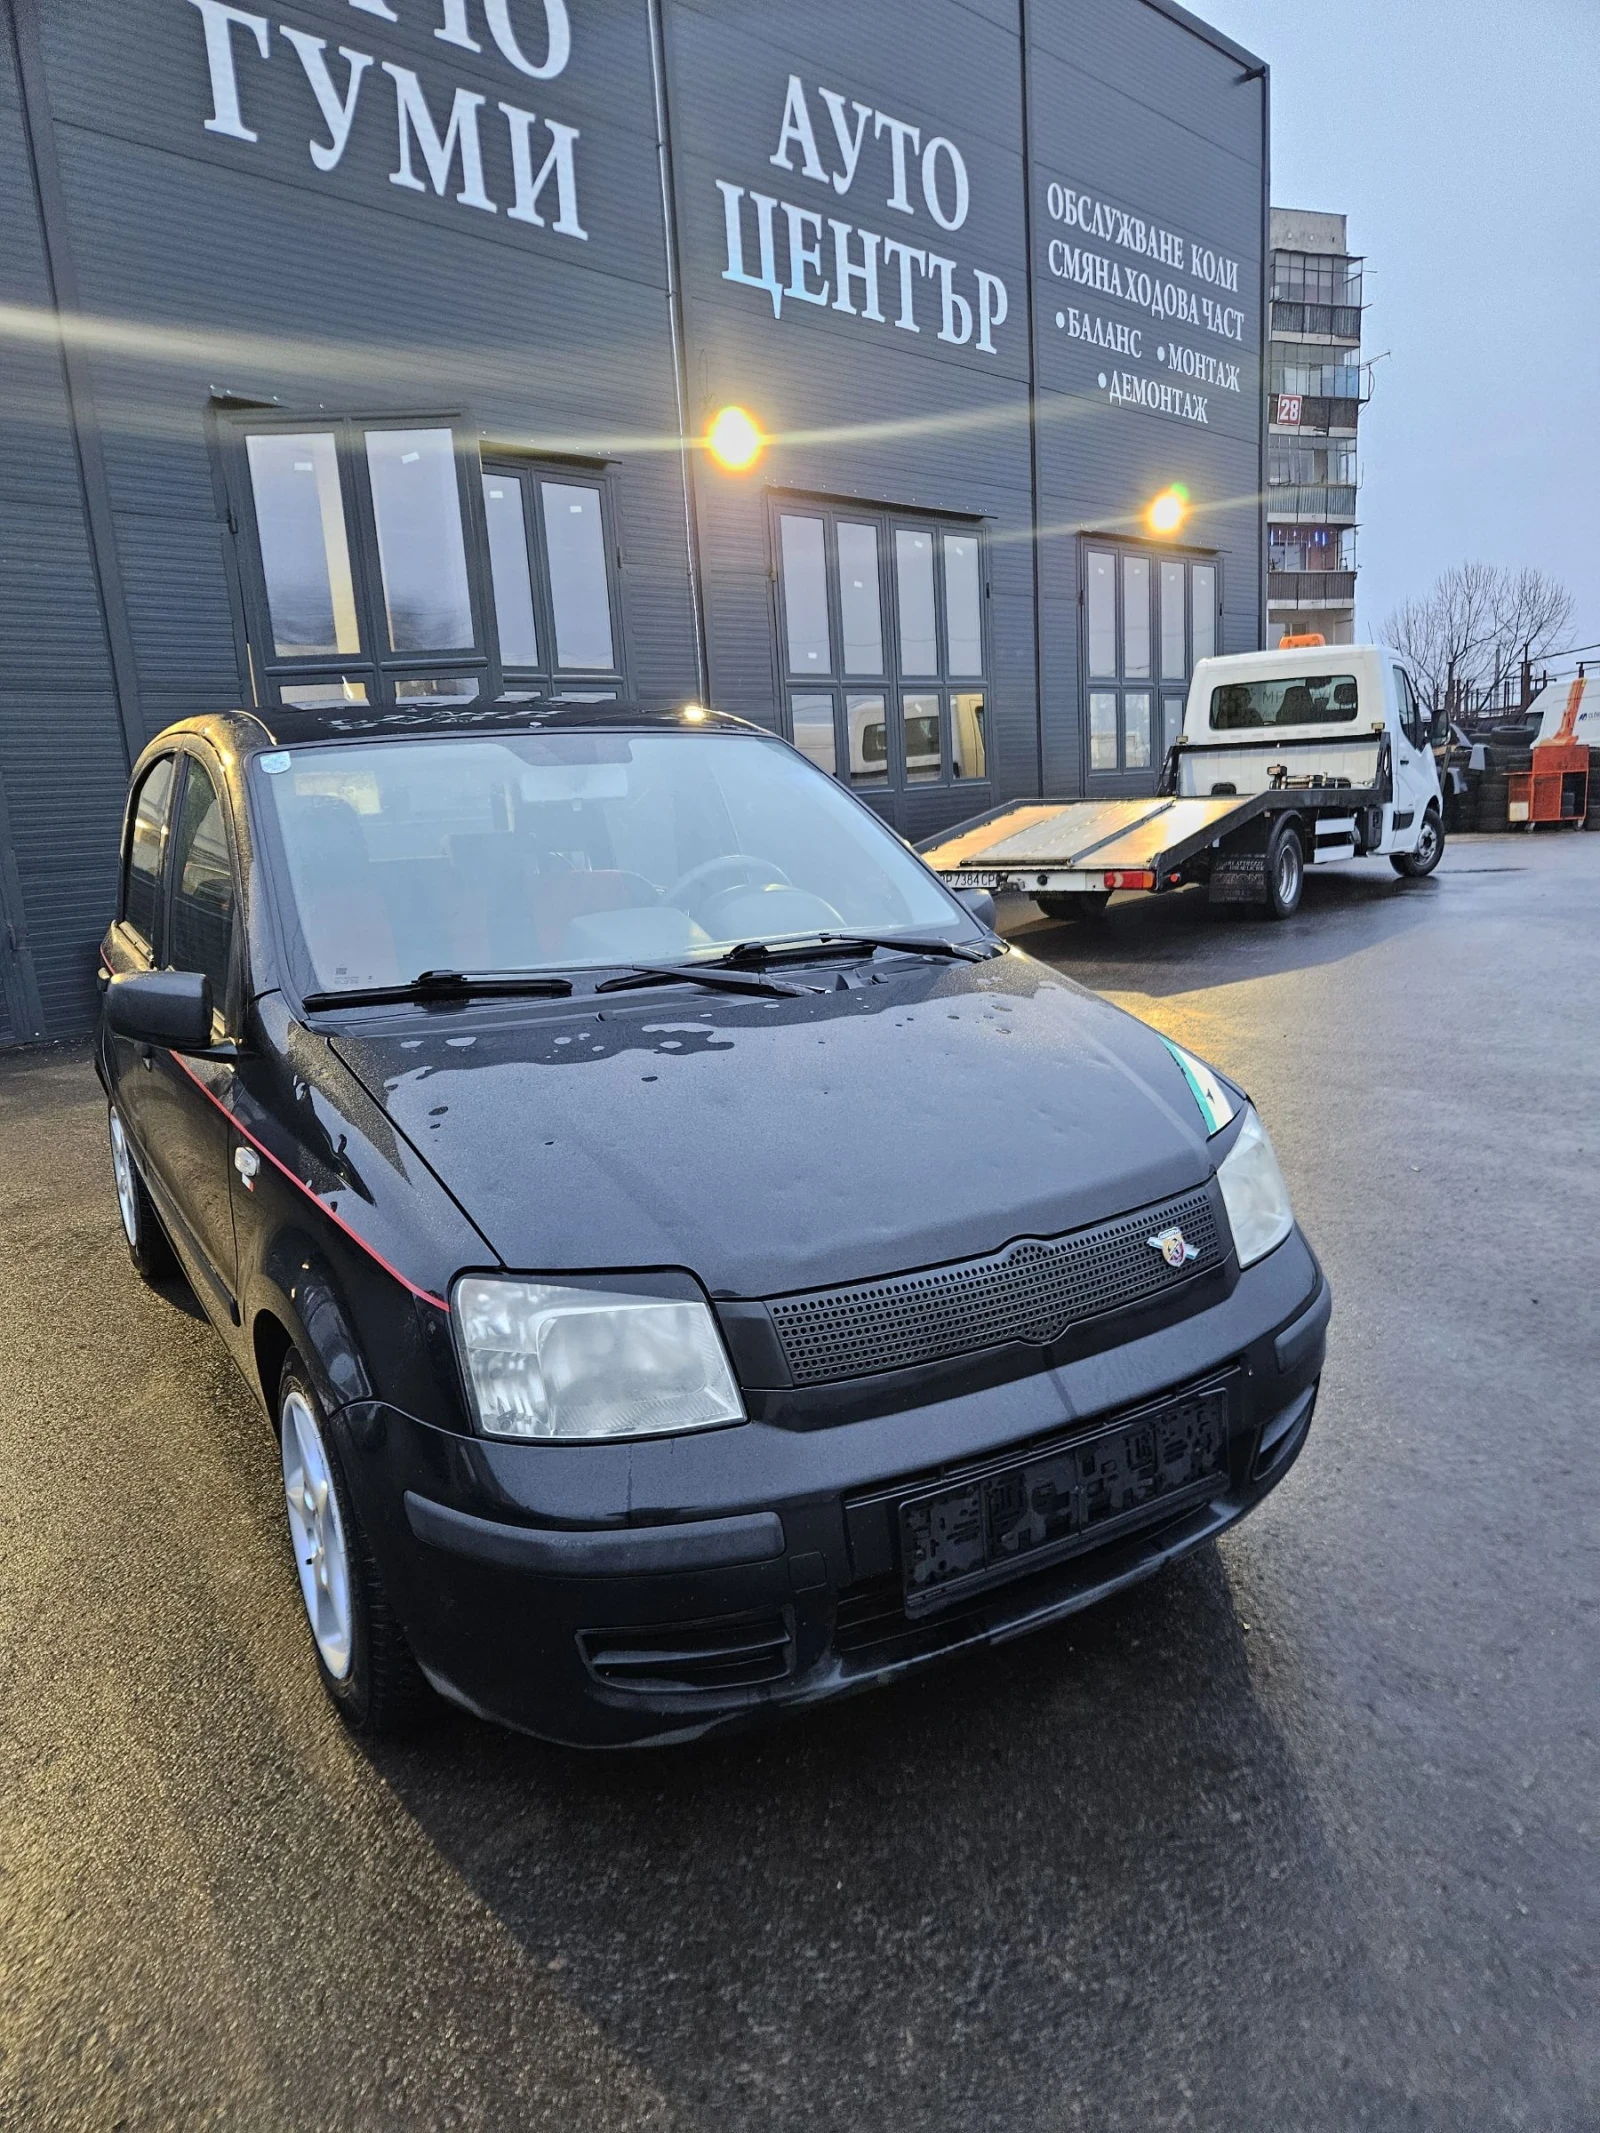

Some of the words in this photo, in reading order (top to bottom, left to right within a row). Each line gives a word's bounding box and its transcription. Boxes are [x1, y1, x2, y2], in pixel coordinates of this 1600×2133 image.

[187, 0, 588, 241] ГУМИ
[769, 74, 970, 231] АУТО
[715, 179, 1008, 355] ЦЕНТЪР
[1047, 182, 1184, 270] ОБСЛУЖВАНЕ
[1190, 243, 1239, 293] КОЛИ
[1048, 239, 1124, 298] СМЯНА
[1124, 267, 1200, 326] ХОДОВА
[1201, 297, 1245, 342] ЧАСТ
[1066, 307, 1142, 359] БАЛАНС
[1108, 370, 1209, 424] ДЕМОНТАЖ
[1167, 342, 1241, 393] МОНТАЖ
[1280, 398, 1299, 420] 28
